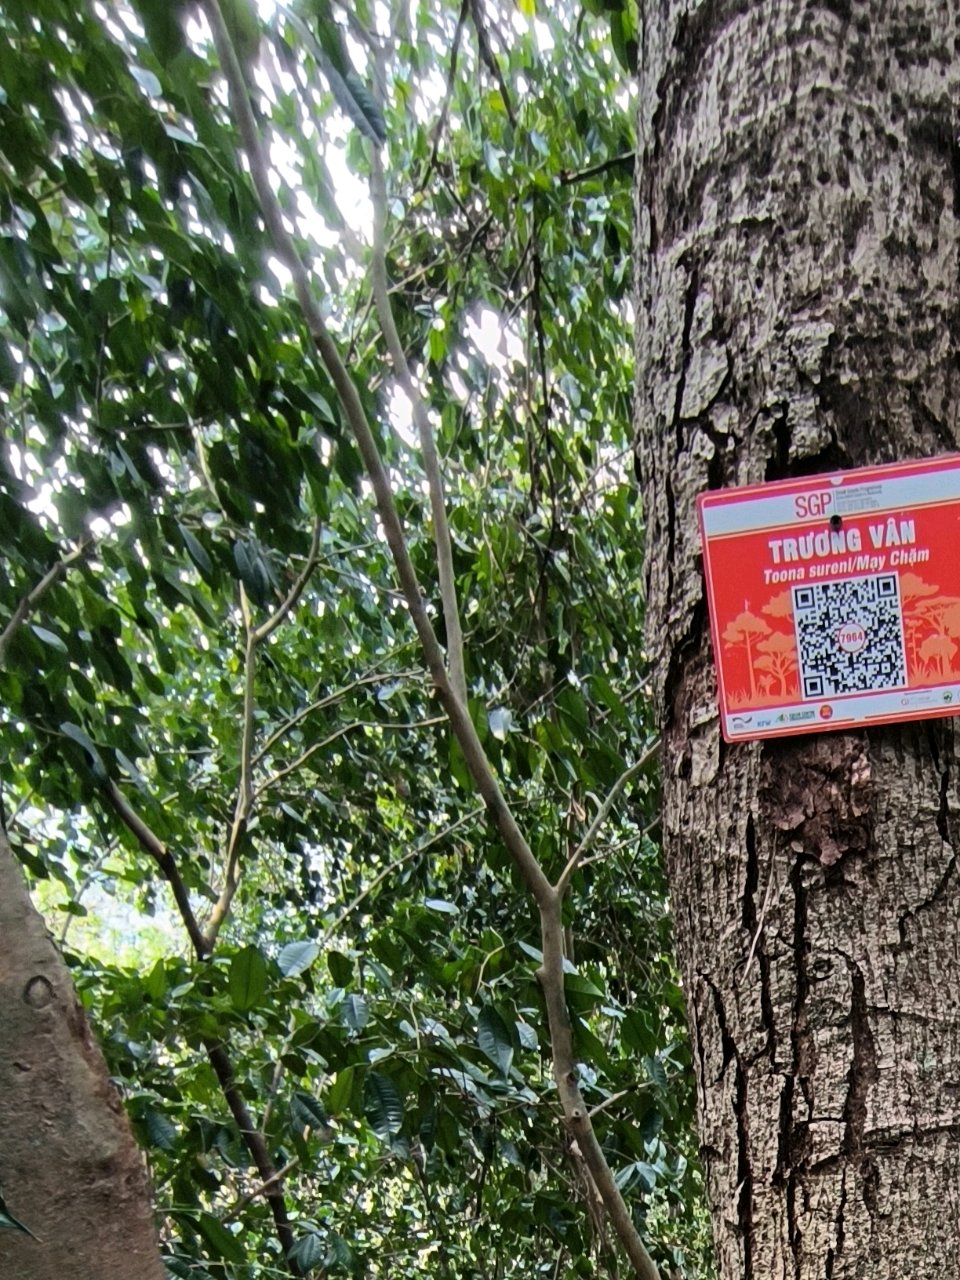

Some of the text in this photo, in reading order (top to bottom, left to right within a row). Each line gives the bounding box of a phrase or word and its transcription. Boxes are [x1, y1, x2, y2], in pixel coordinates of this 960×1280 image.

[795, 492, 832, 518] SGP
[768, 517, 916, 564] TRƯƠNG VÂN
[764, 568, 805, 584] Toona
[890, 548, 930, 567] Chặm
